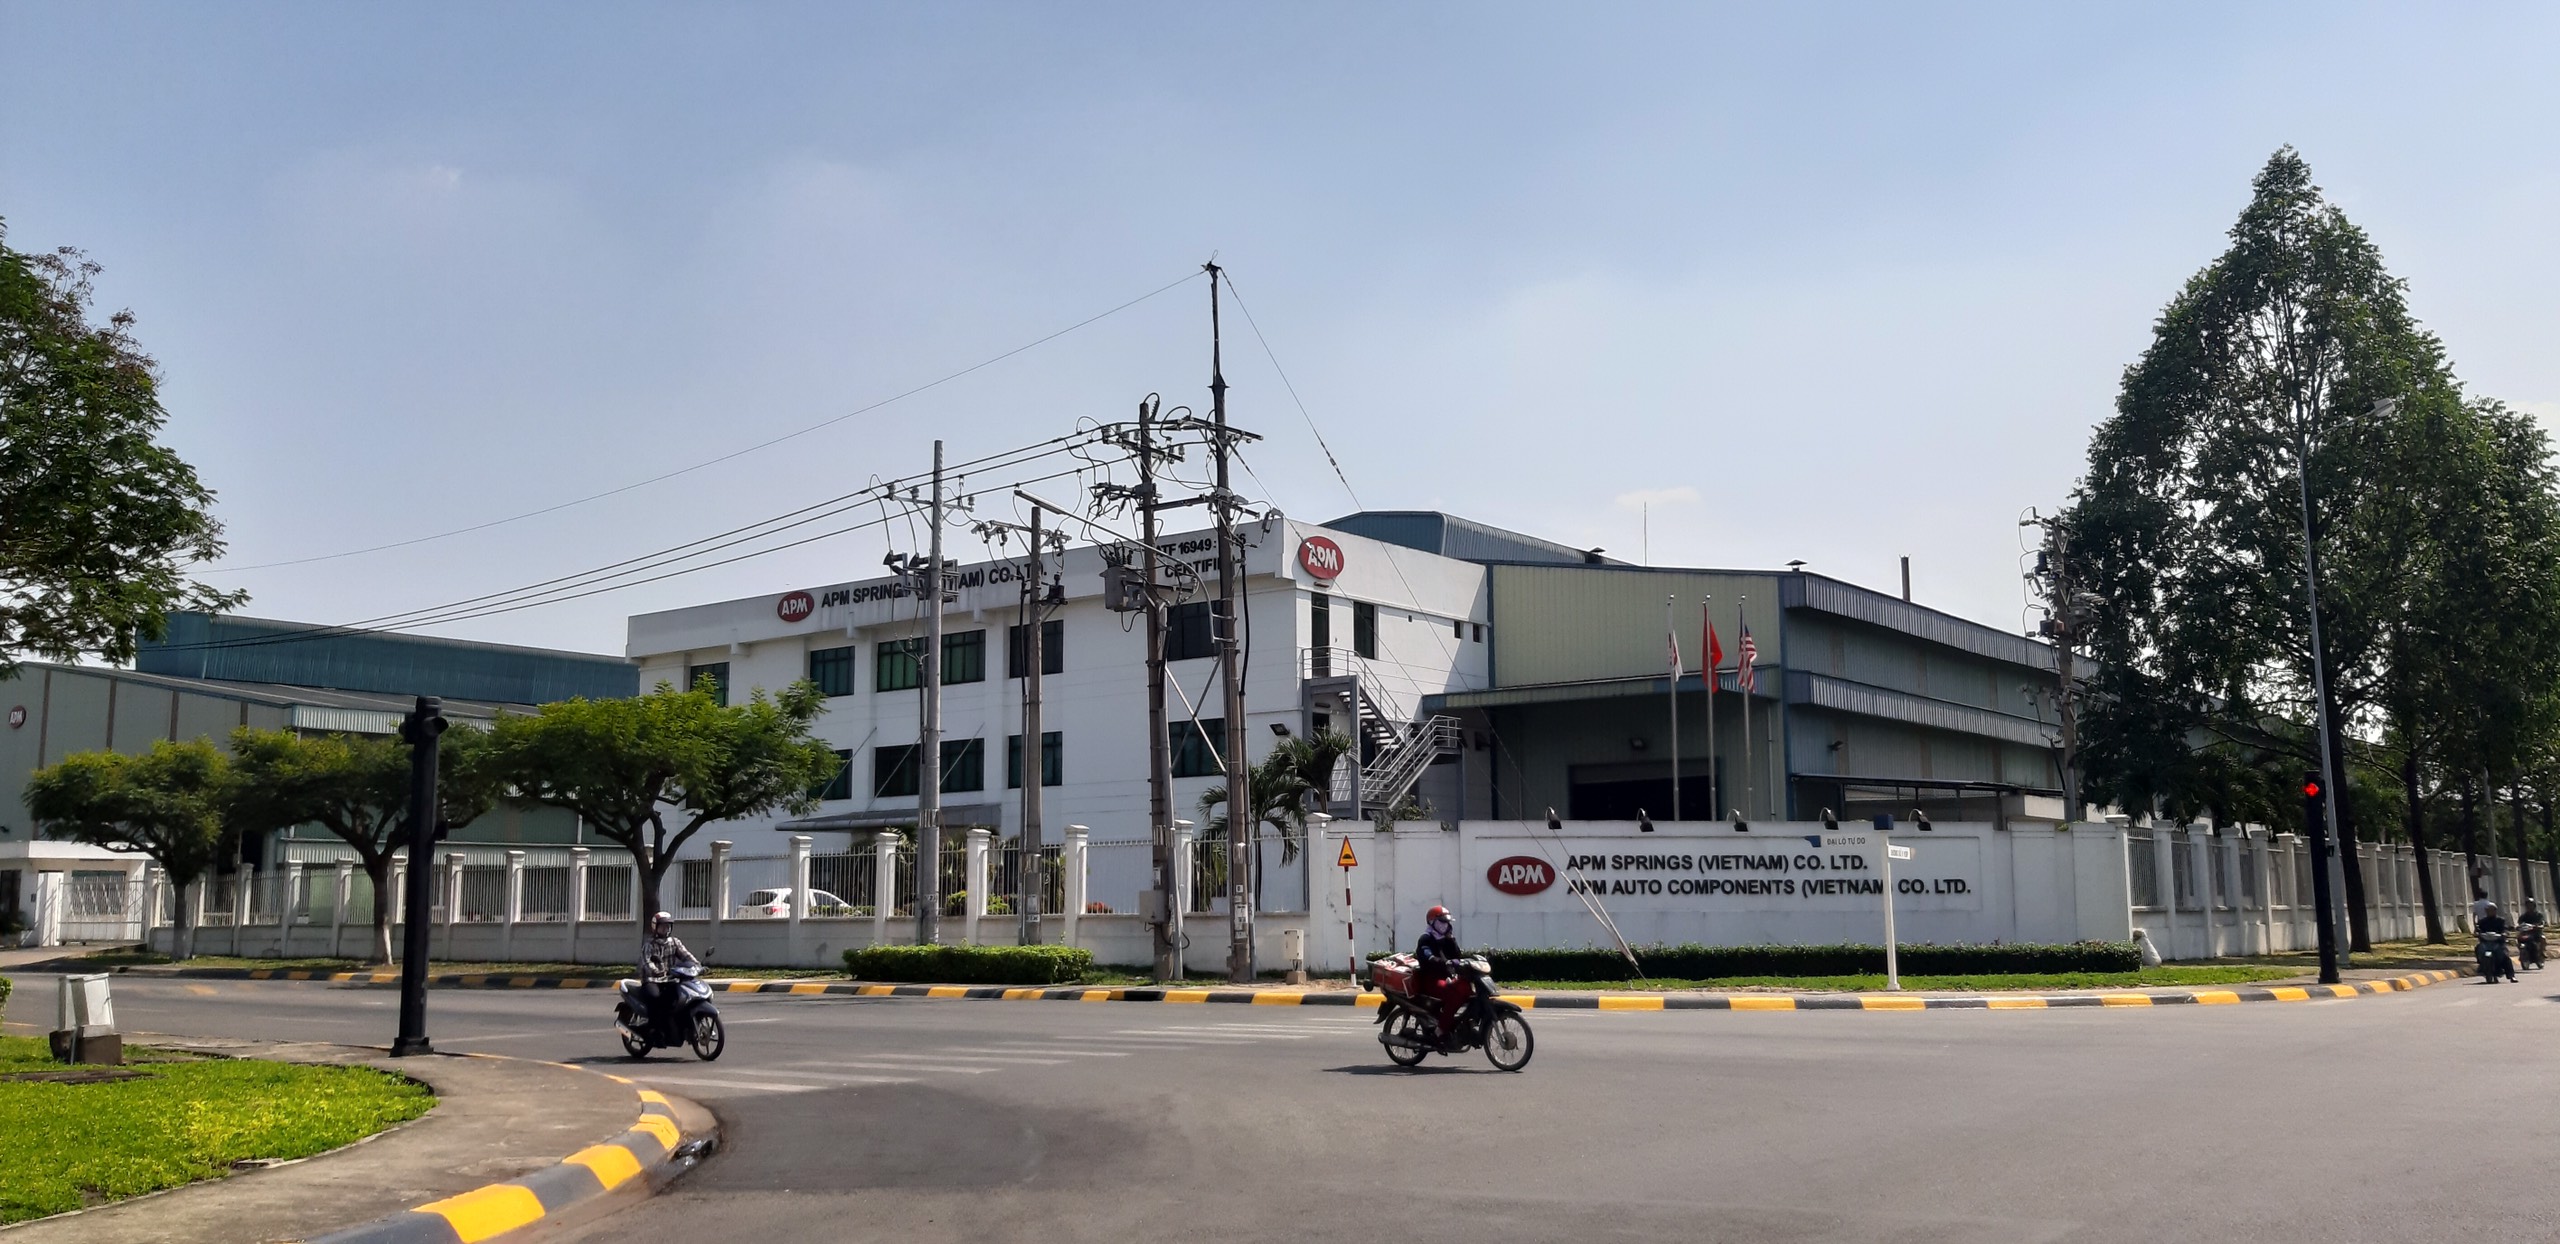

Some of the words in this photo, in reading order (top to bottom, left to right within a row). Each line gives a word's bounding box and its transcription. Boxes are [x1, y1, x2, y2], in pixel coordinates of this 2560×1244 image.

[1165, 555, 1236, 578] CERTIFI
[1307, 544, 1338, 570] APM
[821, 591, 849, 608] APM
[989, 566, 1014, 584] CO.
[781, 598, 808, 616] APM
[1857, 837, 1866, 845] DO
[1498, 864, 1546, 884] APM
[1566, 855, 1606, 870] APM
[1611, 855, 1693, 870] SPRINGS
[1698, 855, 1789, 874] (VIETNAM)
[1793, 855, 1825, 870] CO.
[1830, 855, 1868, 870] LTD.
[1567, 880, 1606, 895] APM
[1611, 879, 1662, 895] AUTO
[1667, 879, 1795, 895] COMPONENTS
[1802, 879, 1892, 898] (VIETNAM
[1898, 879, 1929, 894] CO.
[1934, 879, 1971, 894] LTD.
